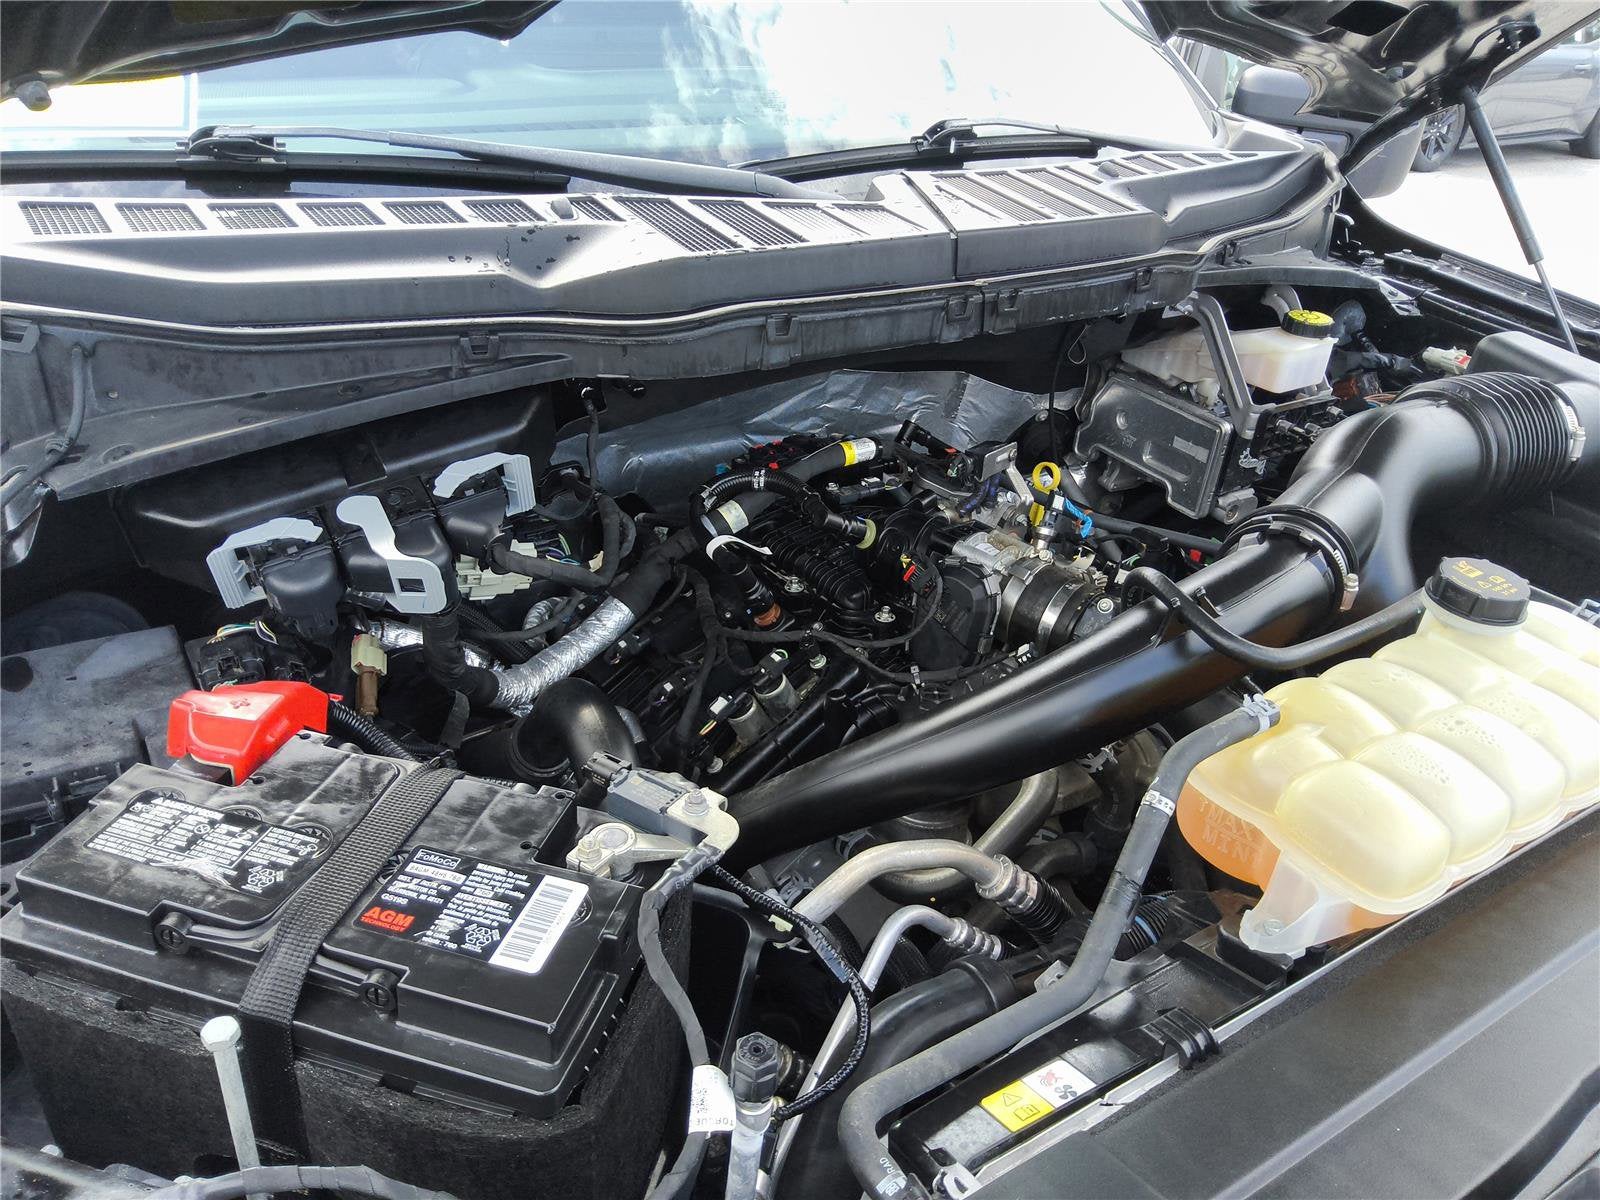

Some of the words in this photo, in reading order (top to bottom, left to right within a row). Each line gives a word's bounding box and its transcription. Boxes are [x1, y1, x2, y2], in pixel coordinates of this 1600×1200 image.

[1203, 824, 1249, 863] MIN
[418, 852, 457, 867] FoMoCo
[362, 906, 416, 928] AGM
[879, 1157, 896, 1174] RAD
